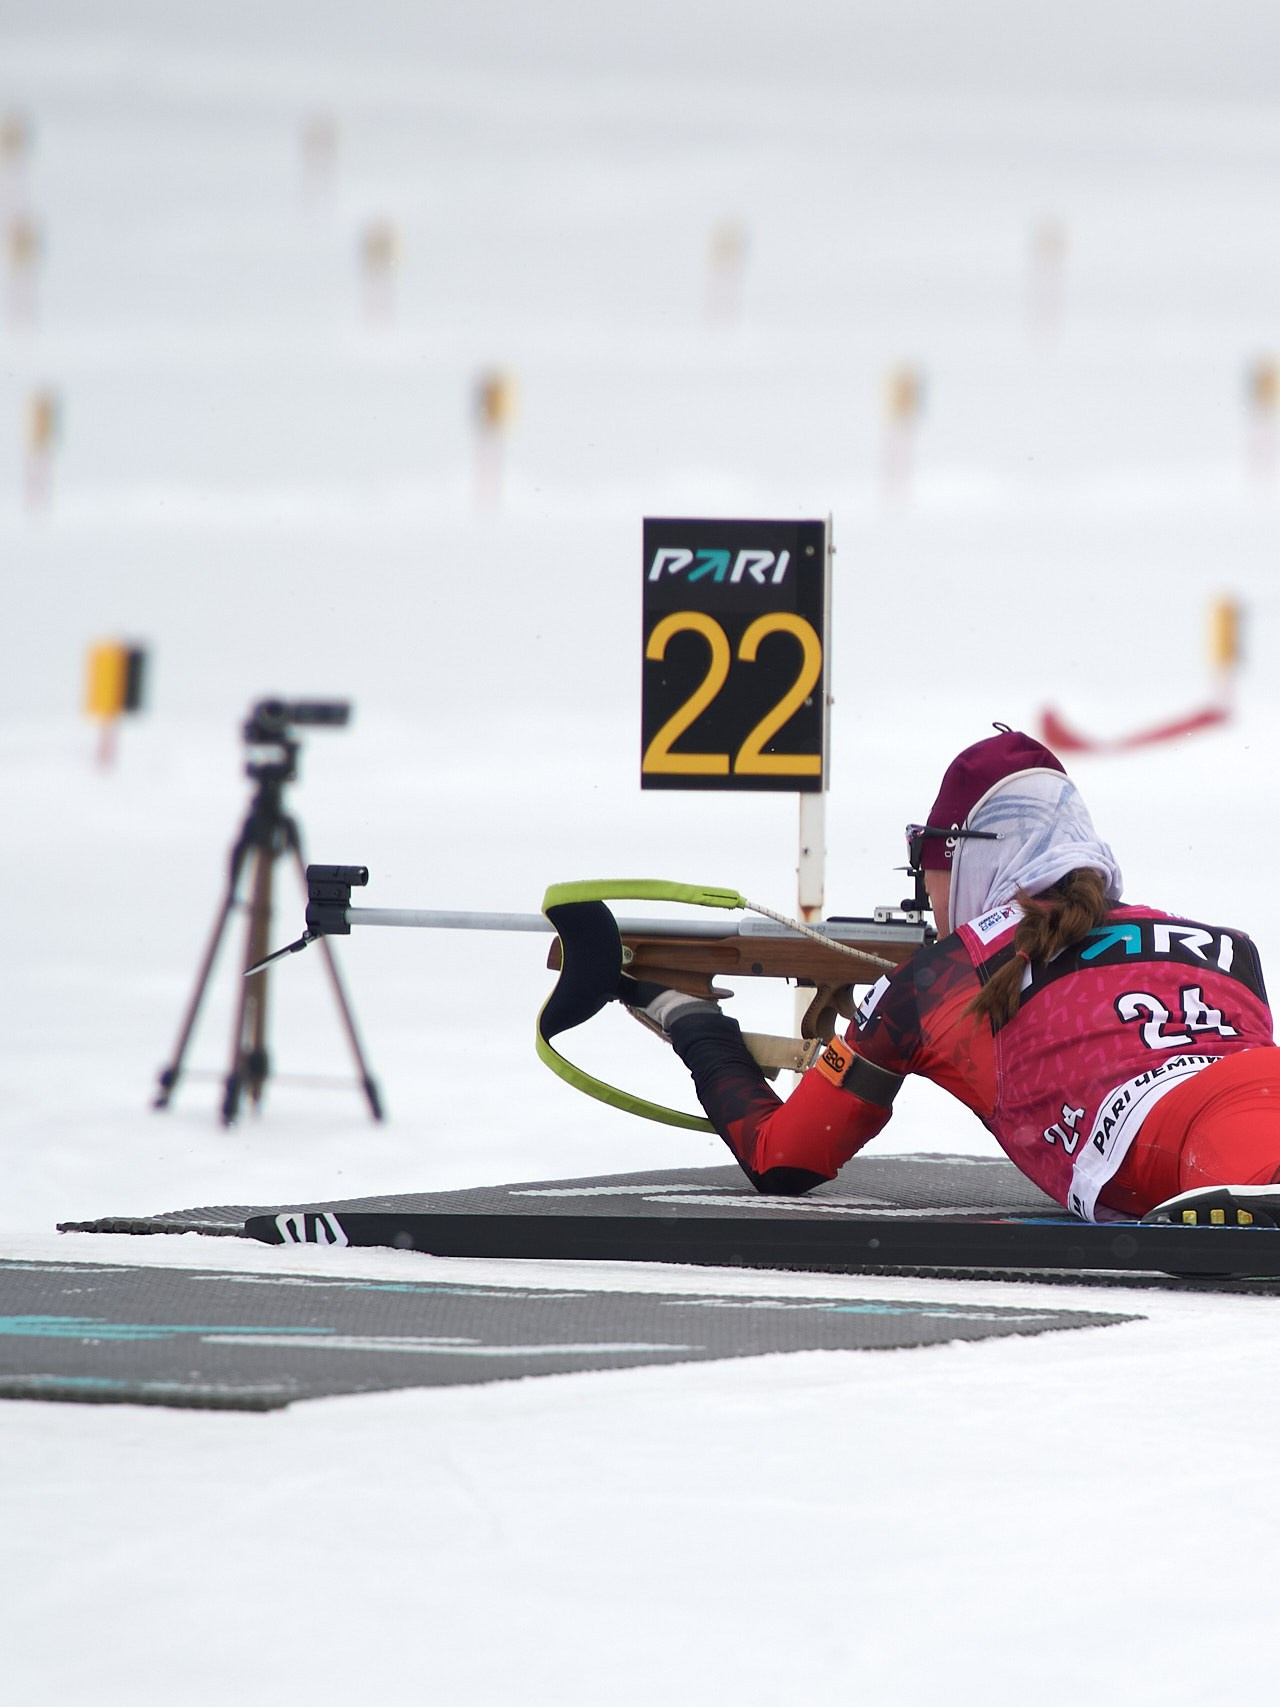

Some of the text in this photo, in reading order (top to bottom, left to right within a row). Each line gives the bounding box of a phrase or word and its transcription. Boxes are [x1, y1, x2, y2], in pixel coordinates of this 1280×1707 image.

[648, 547, 791, 584] PARI
[642, 610, 823, 776] 22
[1021, 923, 1234, 992] ARI
[1115, 984, 1242, 1050] 24
[1043, 1102, 1086, 1157] 24
[1093, 1089, 1132, 1155] PARI
